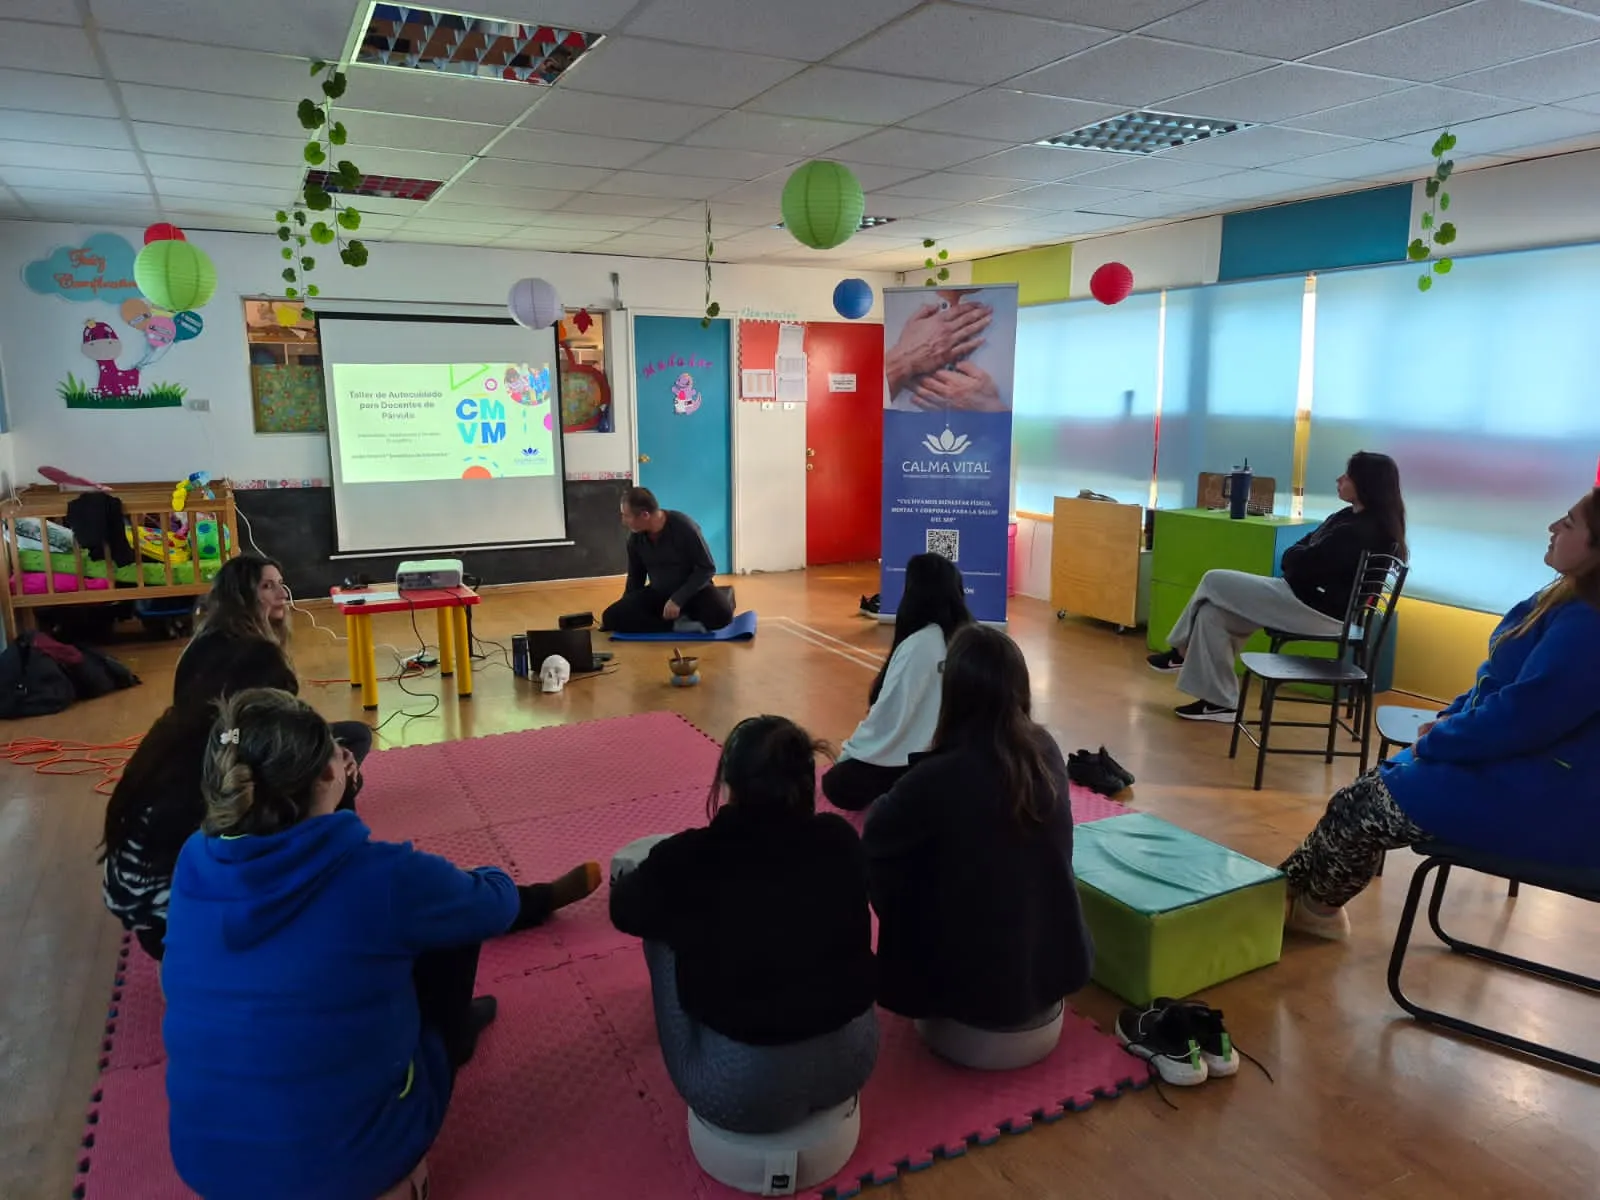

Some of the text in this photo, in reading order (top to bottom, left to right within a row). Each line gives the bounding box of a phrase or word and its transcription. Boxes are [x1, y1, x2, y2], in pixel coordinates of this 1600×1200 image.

[376, 391, 387, 399] de
[389, 391, 443, 399] Autocuidado
[359, 401, 435, 411] para Docentes de
[902, 461, 991, 473] CALMA VITAL
